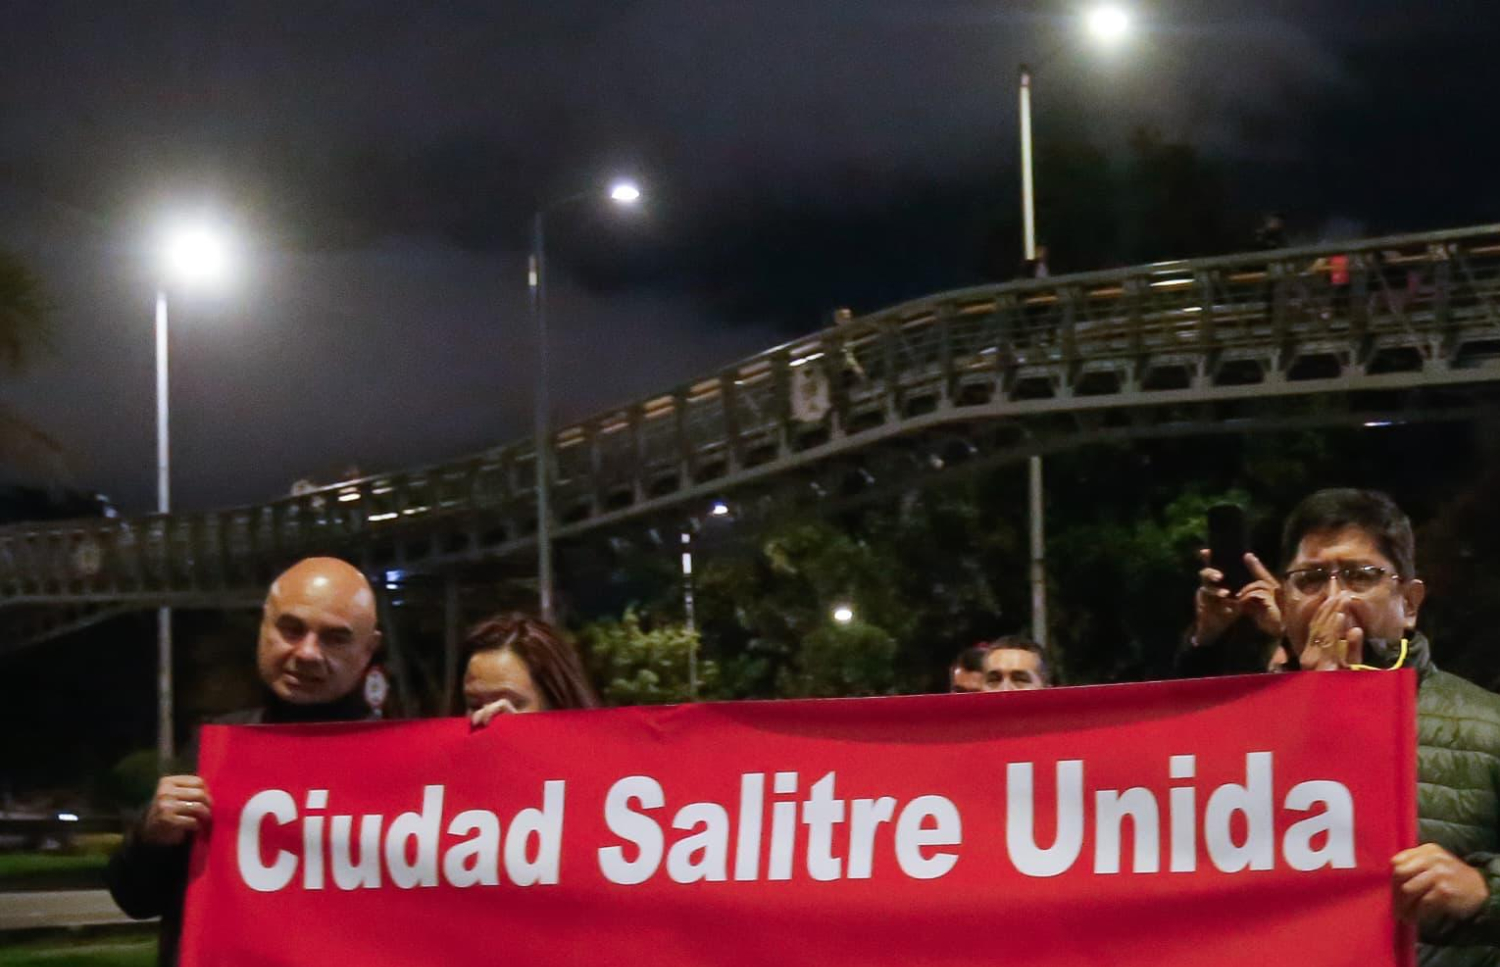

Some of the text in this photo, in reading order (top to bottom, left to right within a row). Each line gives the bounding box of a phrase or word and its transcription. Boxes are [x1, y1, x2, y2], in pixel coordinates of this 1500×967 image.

[237, 751, 1357, 892] Ciudad Salitre Unida
